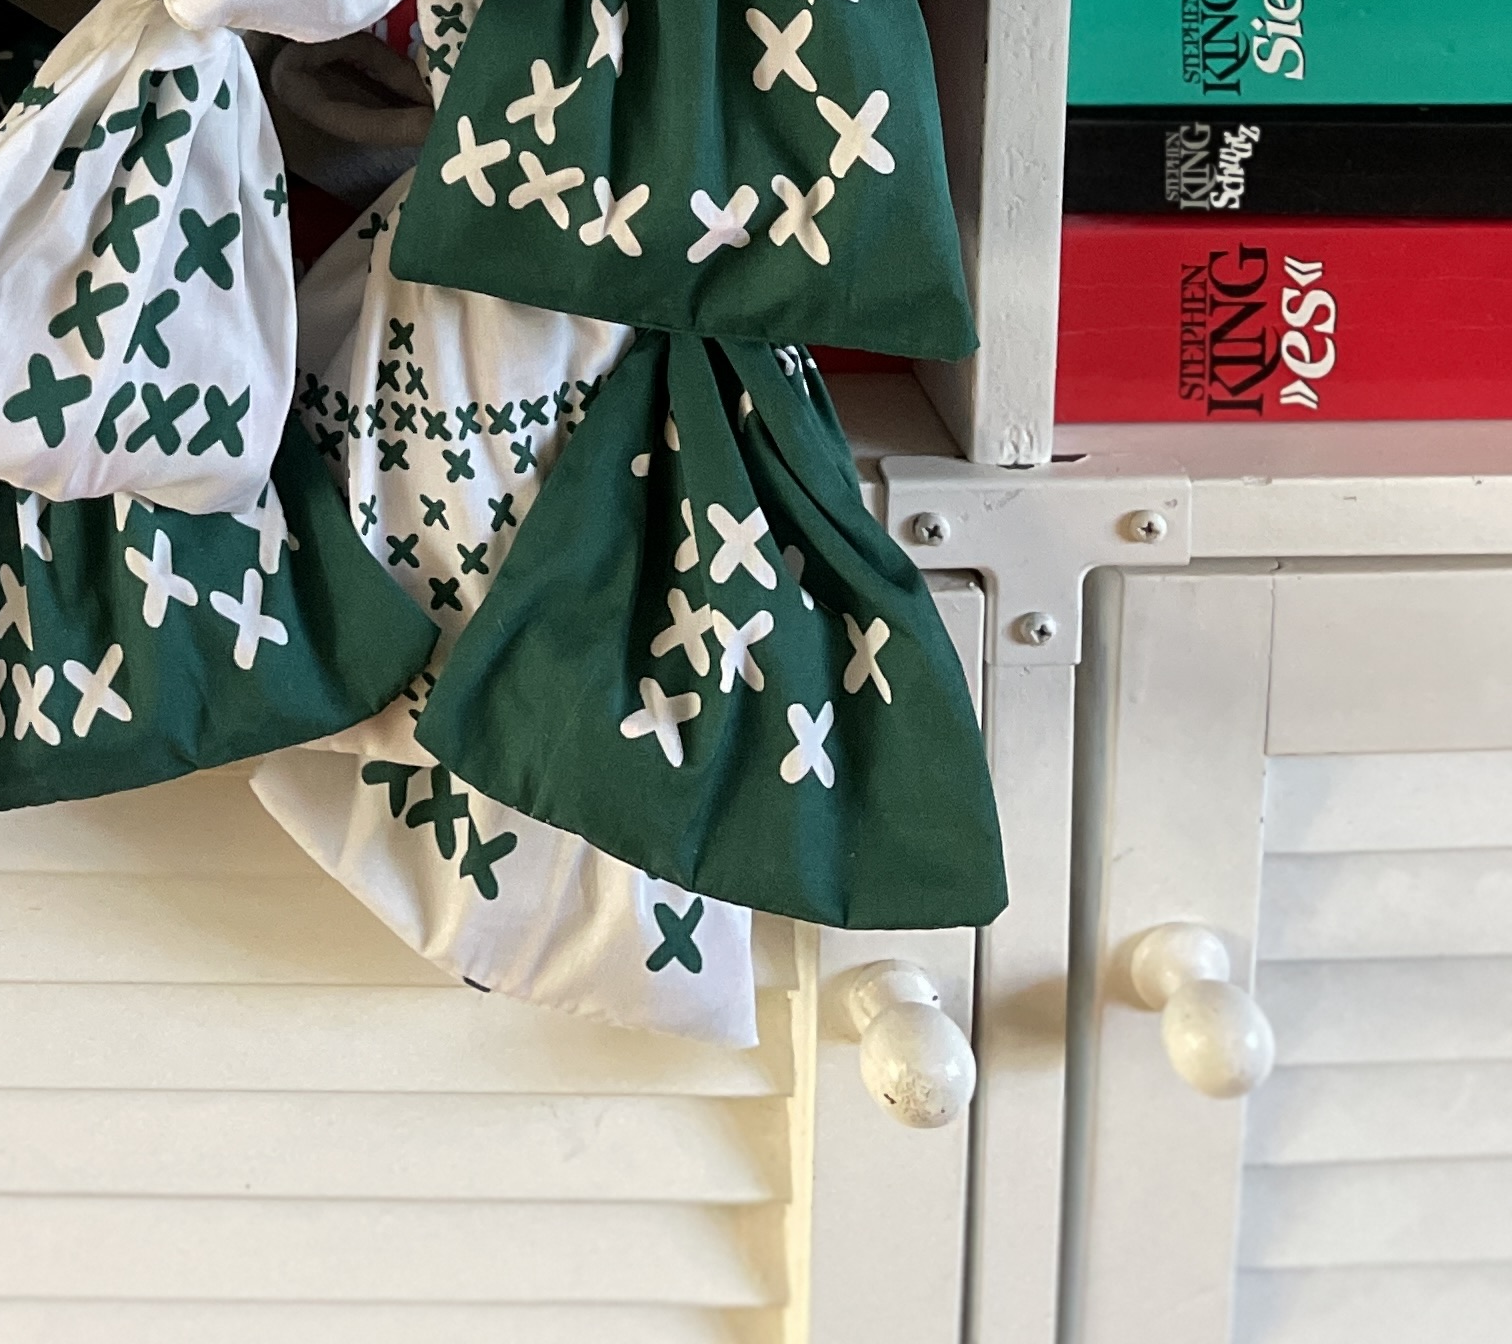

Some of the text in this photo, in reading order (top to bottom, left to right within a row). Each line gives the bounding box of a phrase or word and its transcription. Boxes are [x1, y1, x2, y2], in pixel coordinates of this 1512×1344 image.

[1166, 132, 1180, 201] STEPHEN
[1180, 122, 1217, 211] KING
[1180, 264, 1208, 401] STEPHEN
[1207, 243, 1282, 416] KING
